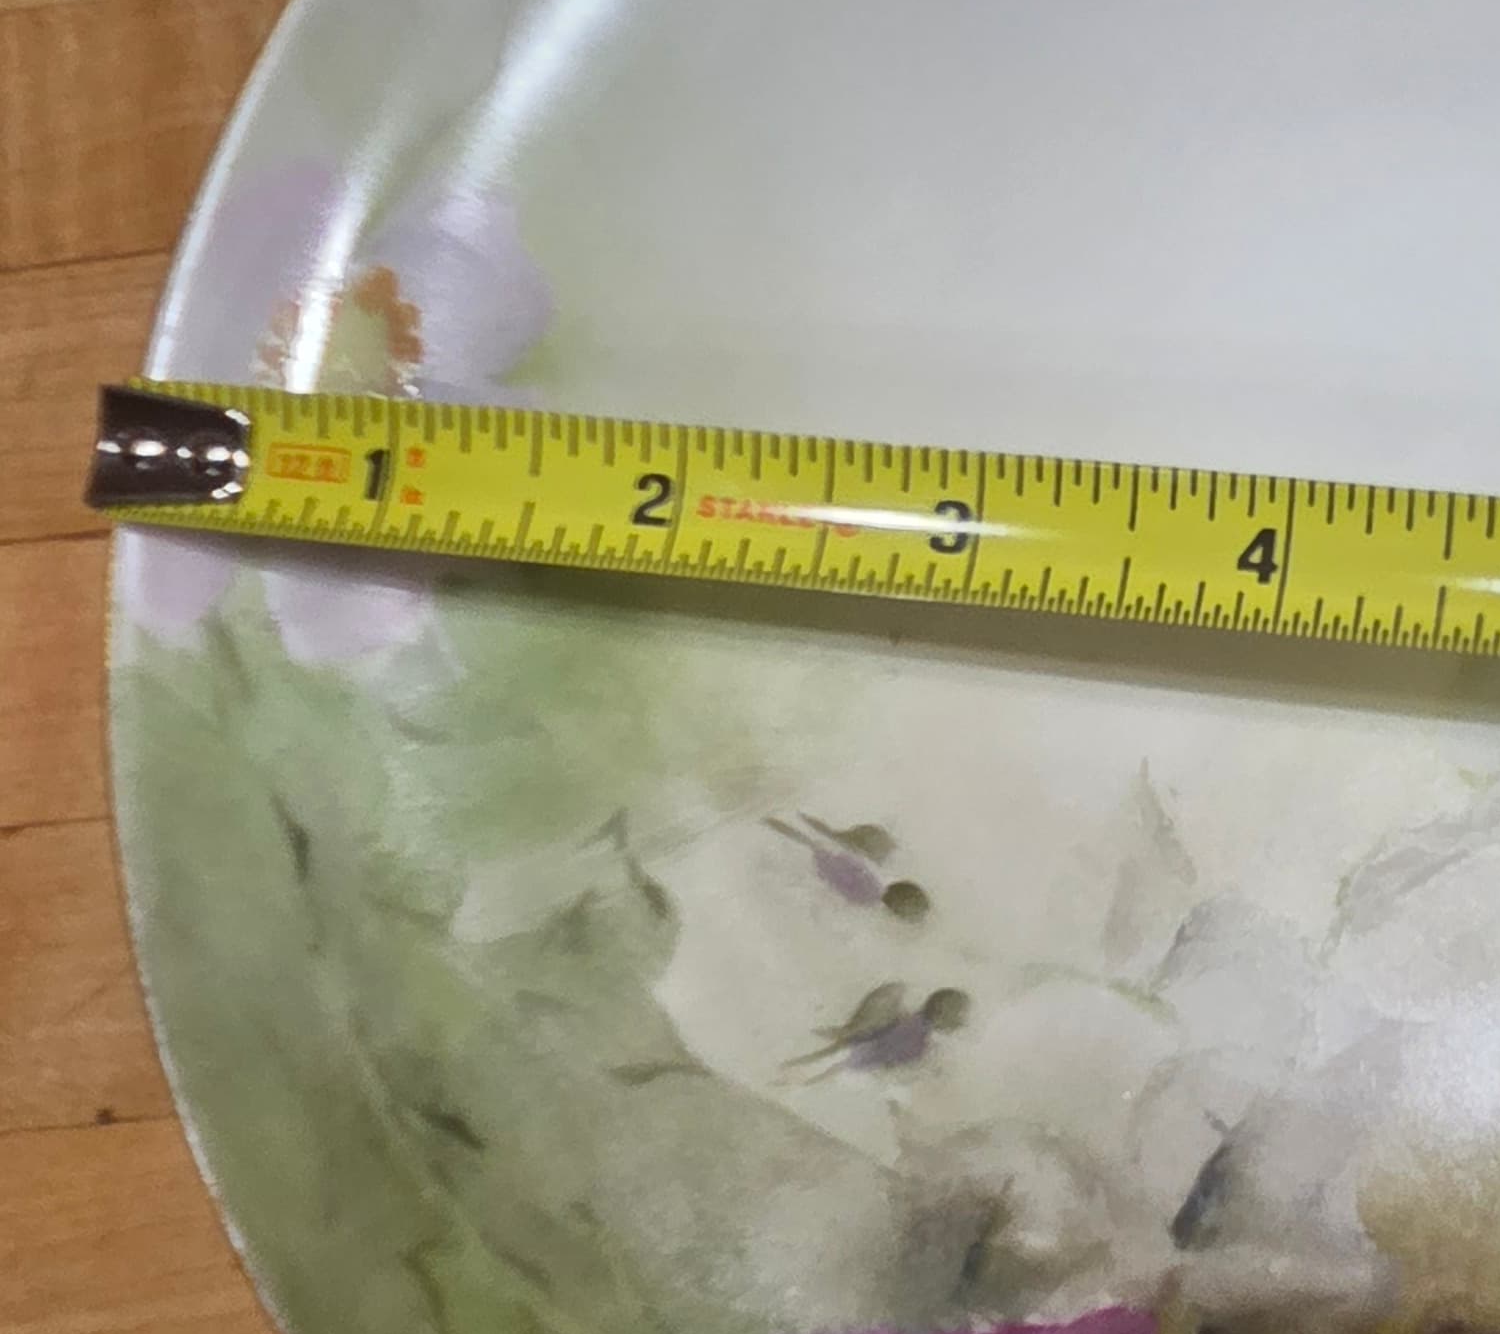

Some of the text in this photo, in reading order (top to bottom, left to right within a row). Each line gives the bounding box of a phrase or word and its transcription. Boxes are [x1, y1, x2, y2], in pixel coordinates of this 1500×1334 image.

[365, 449, 389, 500] 1
[633, 474, 673, 526] 2
[929, 500, 972, 554] 3
[1237, 528, 1278, 584] 4
